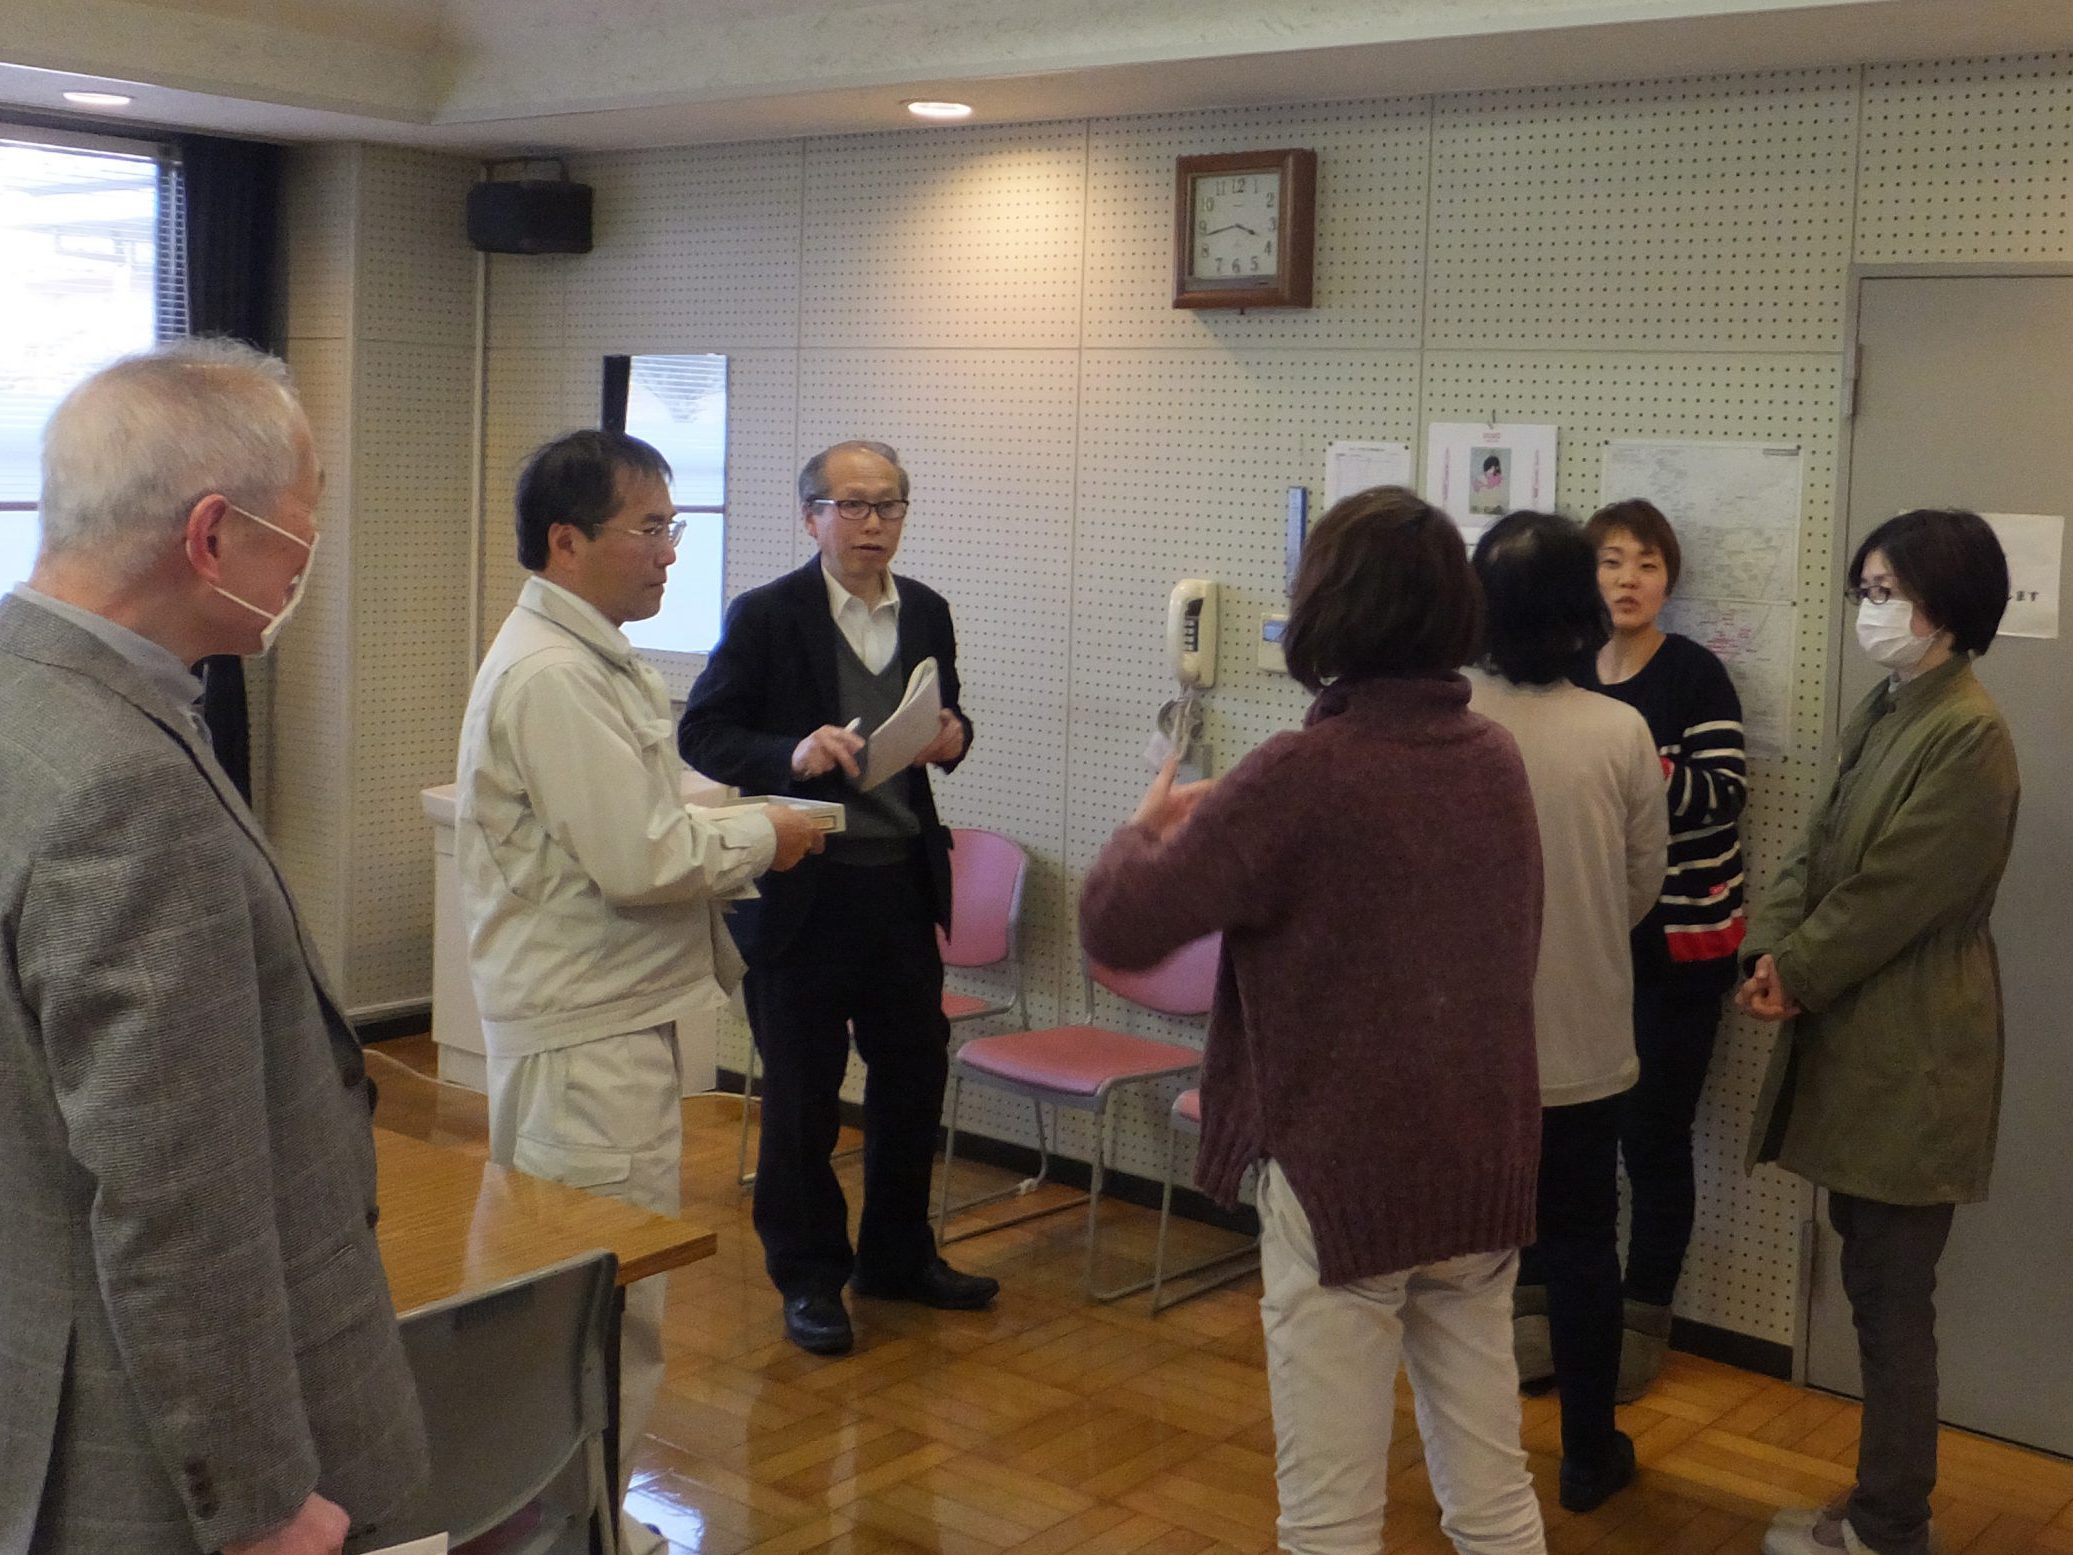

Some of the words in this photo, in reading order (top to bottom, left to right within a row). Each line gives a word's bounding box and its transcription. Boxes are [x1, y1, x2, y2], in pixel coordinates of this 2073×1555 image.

[1216, 180, 1226, 196] 11
[1232, 178, 1245, 194] 12
[1254, 180, 1259, 194] 1
[1201, 197, 1215, 212] 10
[1266, 192, 1275, 208] 2
[1264, 240, 1273, 256] 4
[1214, 257, 1223, 272] 7
[1231, 258, 1241, 273] 6
[1250, 256, 1259, 272] 5
